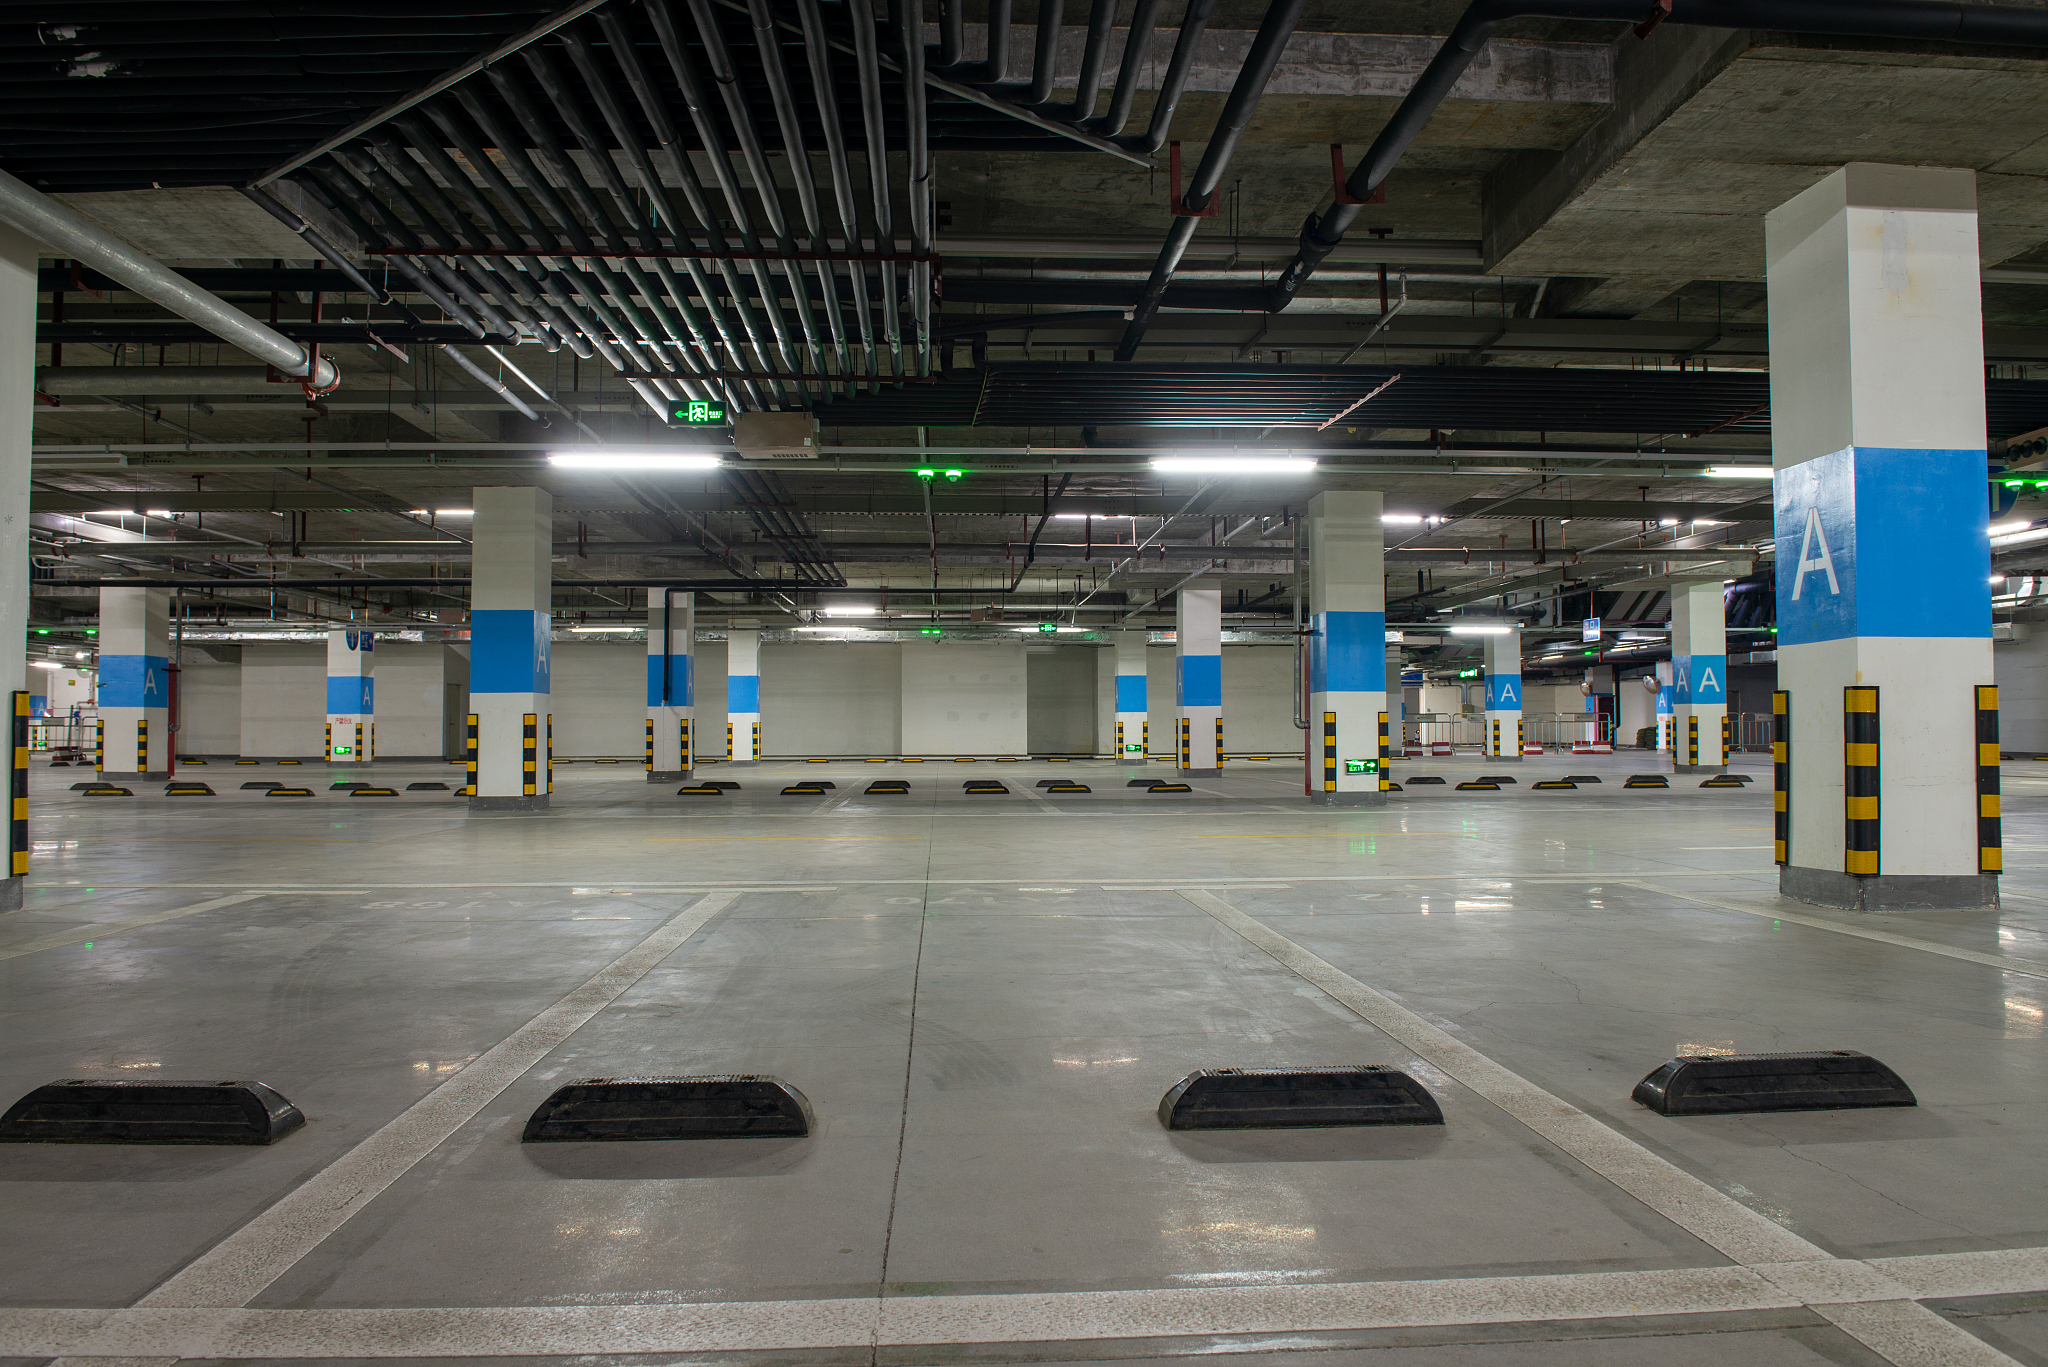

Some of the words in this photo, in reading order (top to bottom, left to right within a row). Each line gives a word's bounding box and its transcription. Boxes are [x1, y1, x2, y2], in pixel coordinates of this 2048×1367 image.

[1791, 507, 1840, 600] A
[536, 632, 548, 673] A
[144, 668, 157, 694] A
[687, 668, 693, 694] A
[1177, 668, 1183, 694] A
[1676, 667, 1688, 692] A
[1698, 667, 1721, 692] A
[362, 686, 370, 705] A
[1486, 683, 1494, 702] A
[1500, 683, 1517, 702] A
[1658, 692, 1666, 707] A
[38, 702, 44, 714] A
